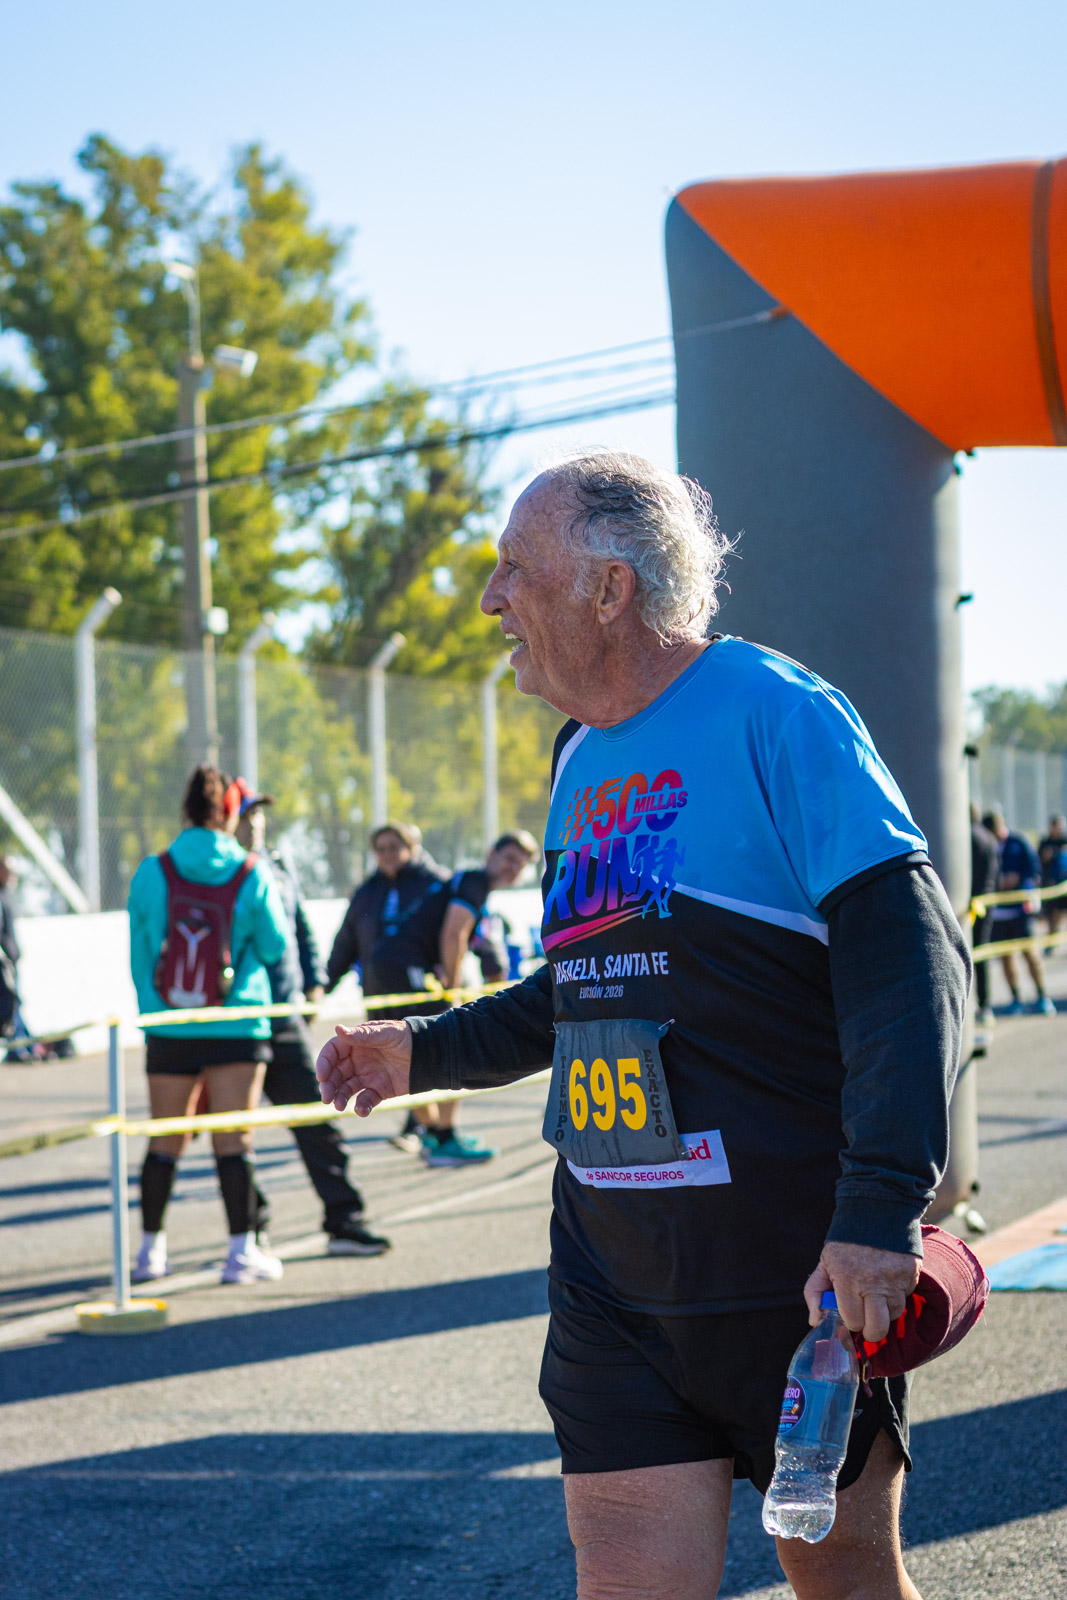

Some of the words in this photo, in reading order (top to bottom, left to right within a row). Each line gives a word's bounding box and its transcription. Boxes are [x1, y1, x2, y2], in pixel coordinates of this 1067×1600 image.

[633, 791, 688, 814] MILLAS
[603, 952, 650, 979] SANTA
[651, 951, 669, 975] FE
[603, 984, 624, 999] 2026
[554, 1056, 568, 1142] TIEMPO
[569, 1058, 647, 1131] 695
[643, 1049, 667, 1138] EXACTO
[595, 1171, 633, 1181] SANCOR
[634, 1170, 684, 1181] SEGUROS
